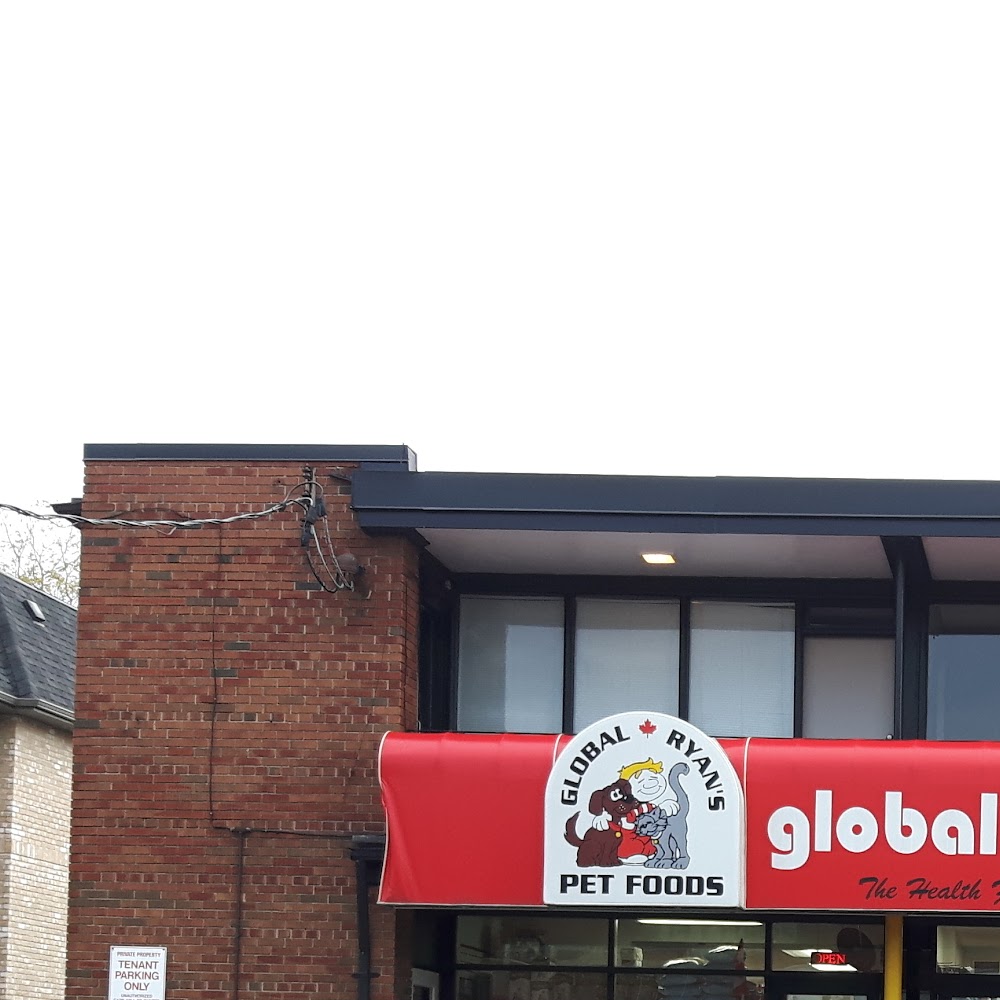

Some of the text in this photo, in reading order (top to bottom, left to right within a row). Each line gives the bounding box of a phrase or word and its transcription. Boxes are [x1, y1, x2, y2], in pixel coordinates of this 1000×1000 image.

[561, 725, 725, 811] GLOBAL RYAN'S
[767, 789, 998, 871] global
[560, 874, 724, 896] PET FOODS
[858, 876, 898, 900] The
[905, 878, 983, 901] Health
[115, 970, 160, 980] PARKING
[118, 960, 159, 969] TENANT
[124, 982, 150, 991] ONLY
